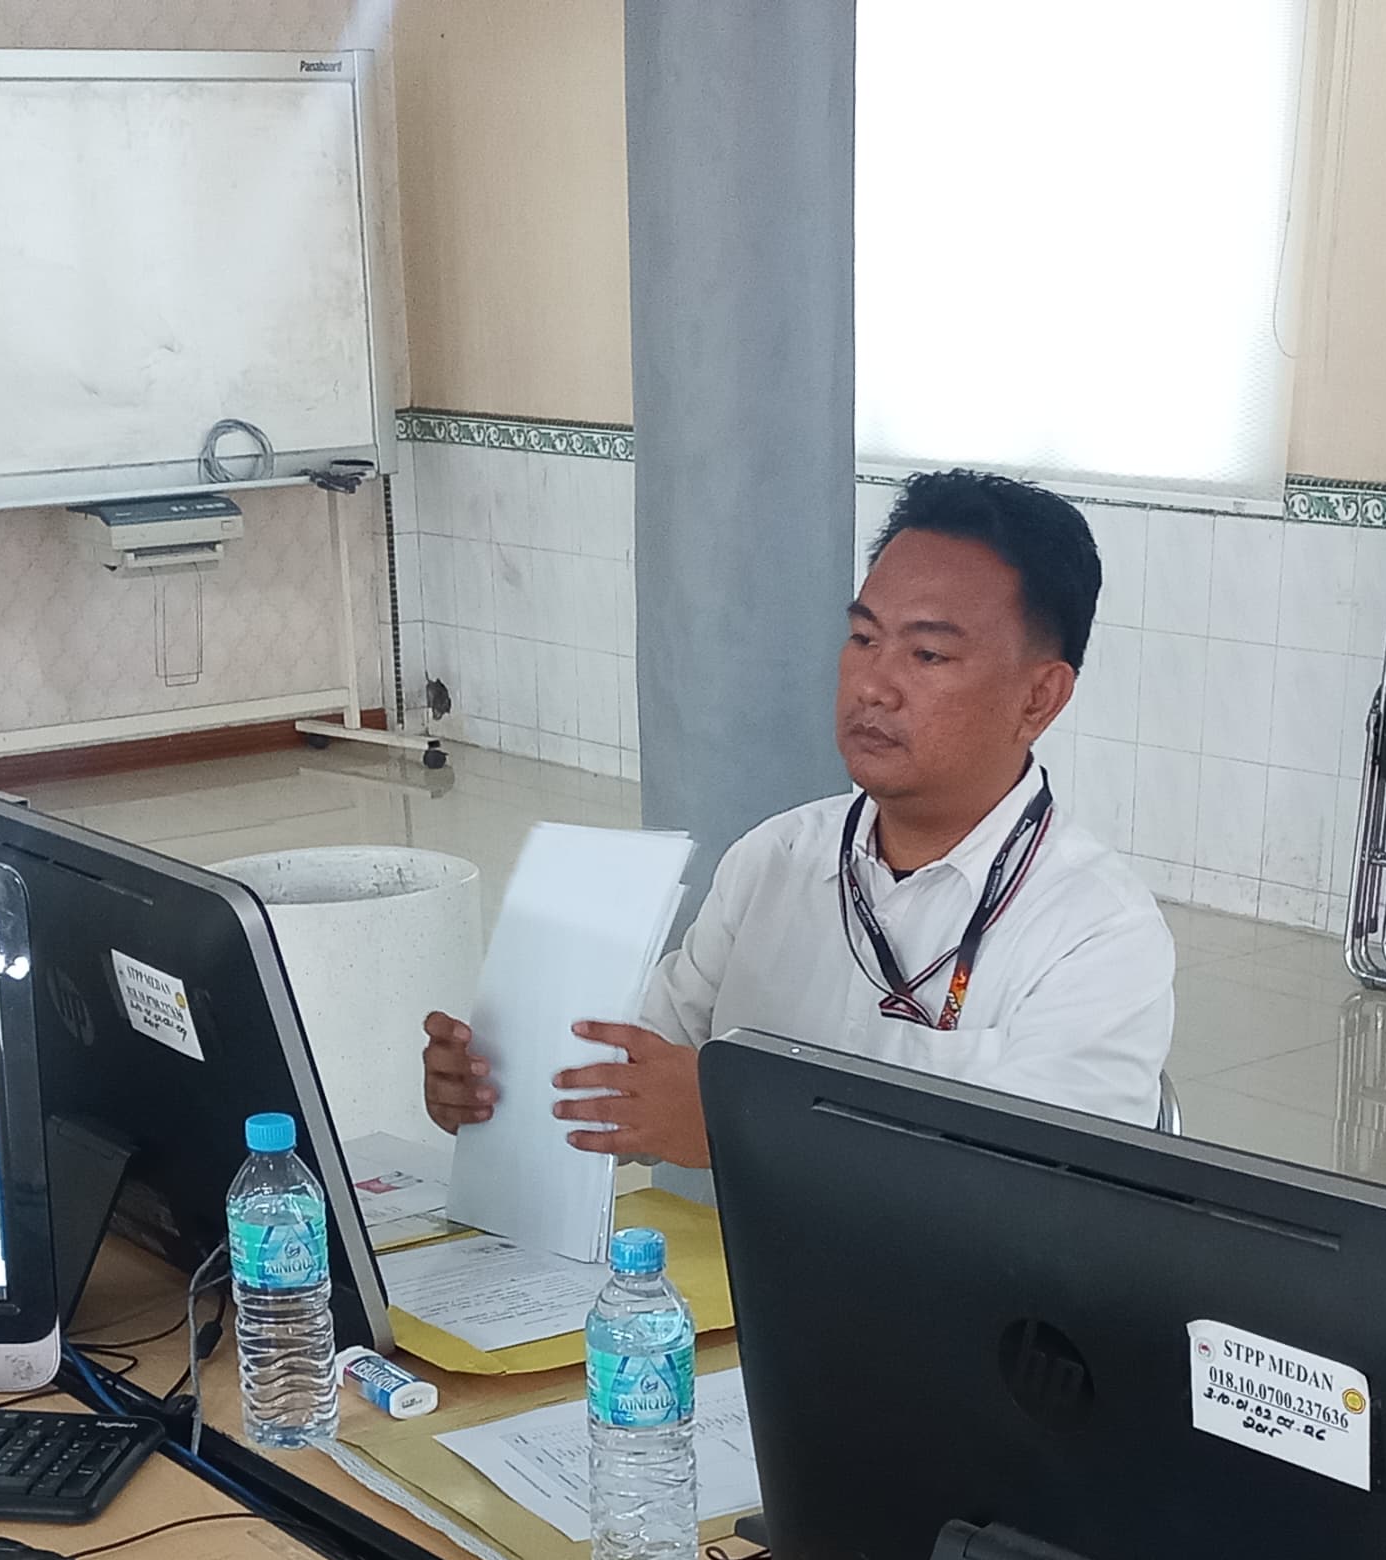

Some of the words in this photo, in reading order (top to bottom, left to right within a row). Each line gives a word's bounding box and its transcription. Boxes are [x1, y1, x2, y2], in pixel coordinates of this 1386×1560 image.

[1223, 1339, 1265, 1367] STPP
[1268, 1354, 1334, 1392] MEDAN
[1209, 1366, 1349, 1429] 018.10.0700.237636
